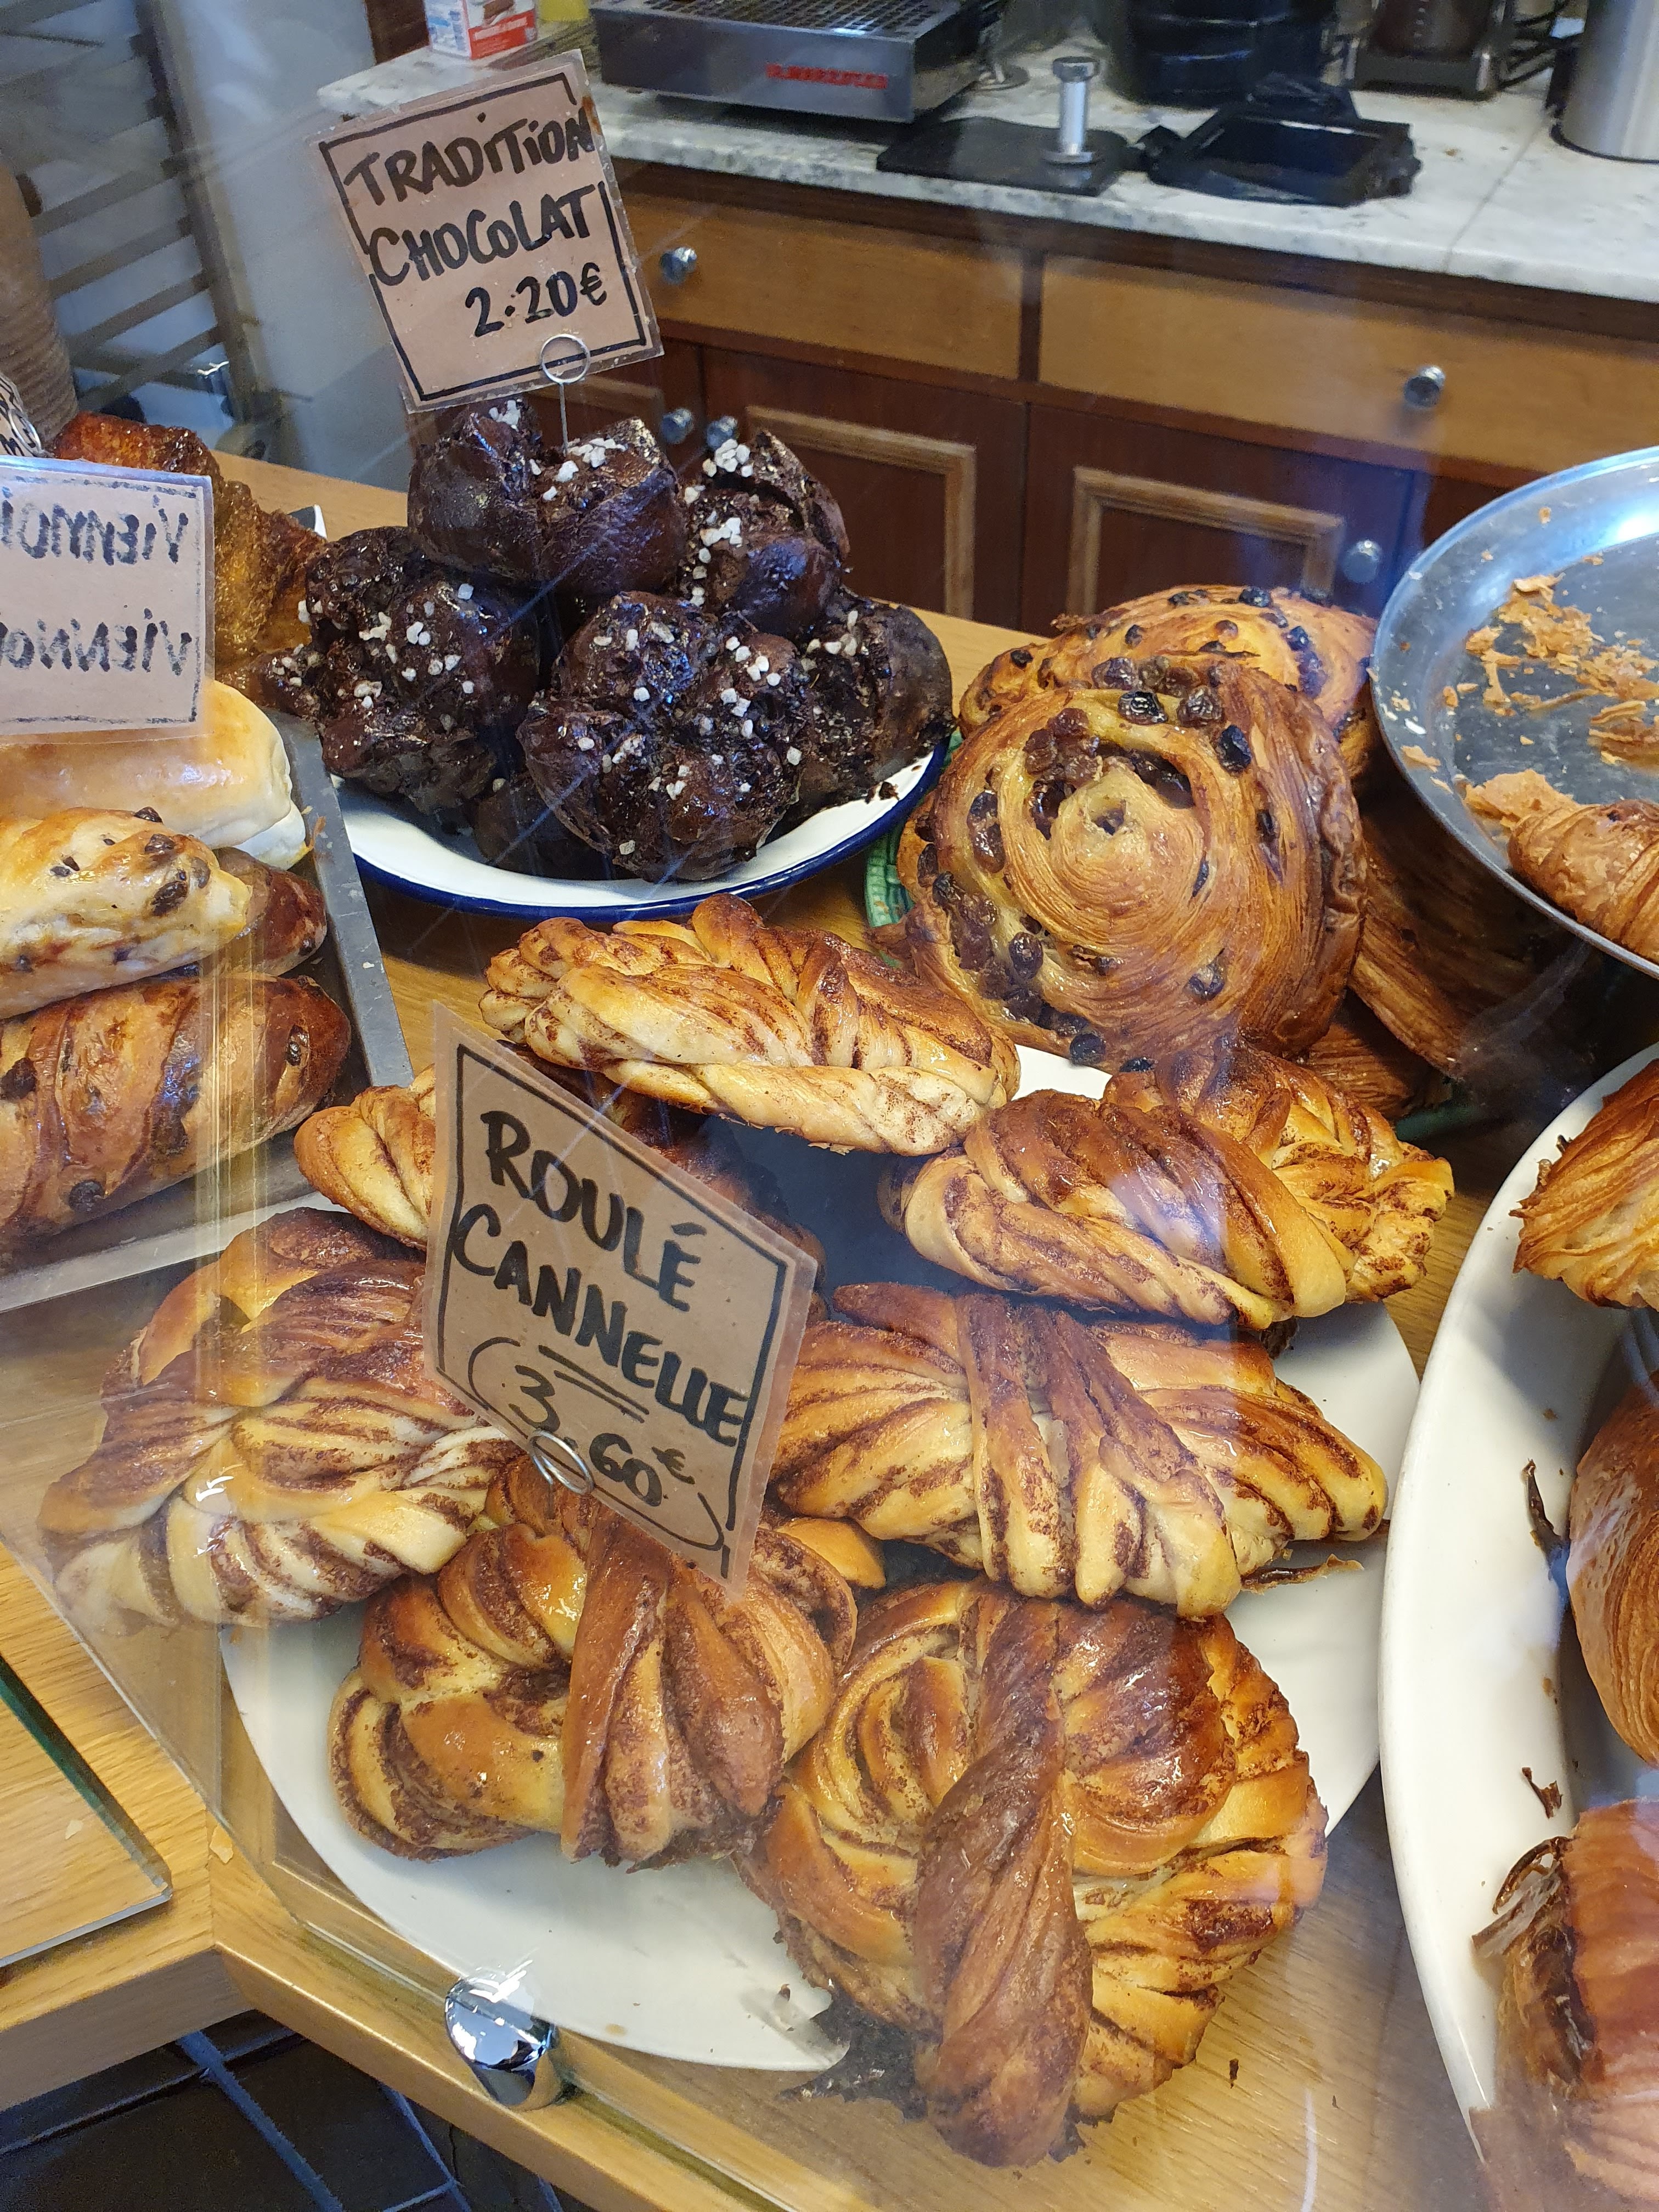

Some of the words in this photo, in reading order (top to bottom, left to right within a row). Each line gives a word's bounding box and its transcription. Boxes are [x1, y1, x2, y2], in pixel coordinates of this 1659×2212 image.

[368, 184, 596, 286] CHOCOLAT
[465, 263, 607, 337] 2.20€
[481, 1111, 707, 1311] ROULÉ
[454, 1203, 749, 1447] CANNELLE
[509, 1364, 696, 1506] 3.60€
